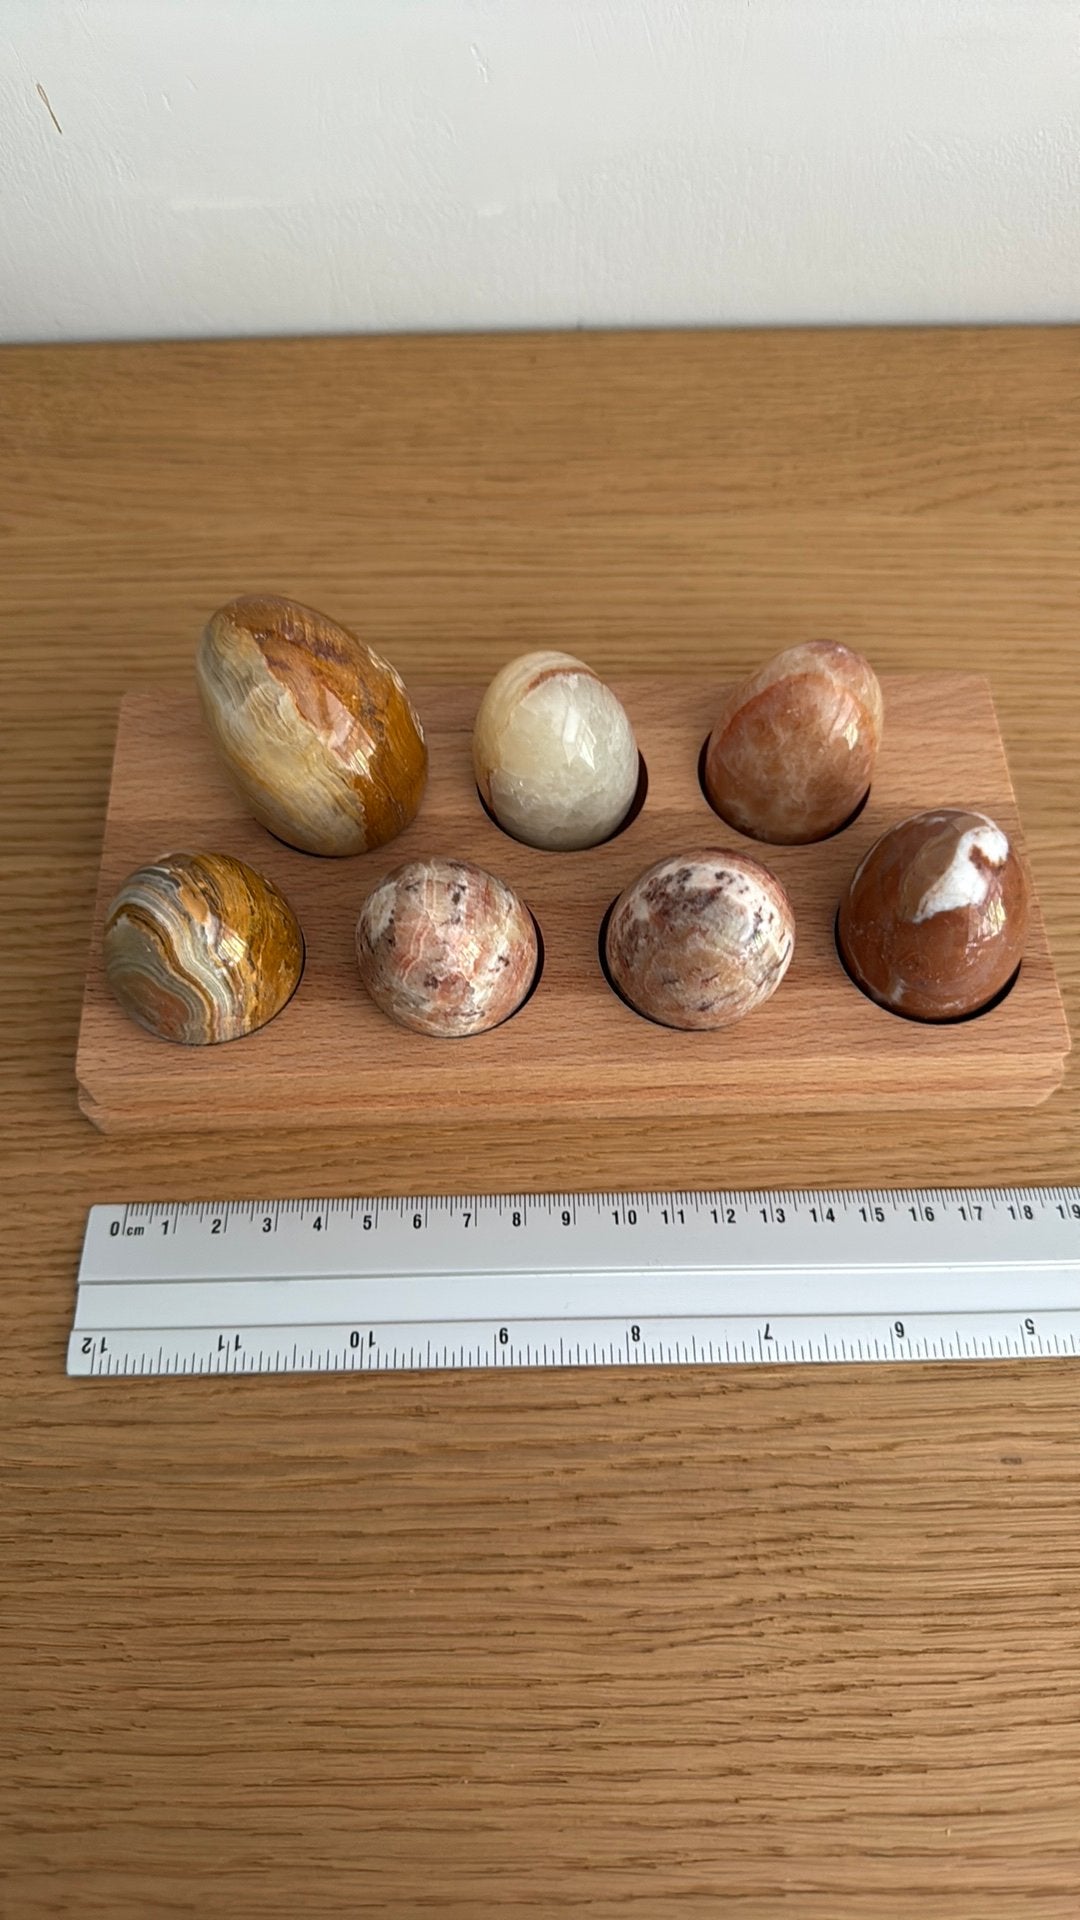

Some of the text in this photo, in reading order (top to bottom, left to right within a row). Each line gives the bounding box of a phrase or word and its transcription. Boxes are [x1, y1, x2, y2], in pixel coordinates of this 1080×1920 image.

[160, 1220, 170, 1236] 1
[210, 1218, 222, 1235] 2
[261, 1217, 272, 1233] 3
[312, 1215, 323, 1232] 4
[362, 1214, 373, 1231] 5
[412, 1213, 423, 1230] 6
[462, 1212, 472, 1229] 7
[511, 1211, 522, 1228] 8
[561, 1210, 571, 1227] 9
[611, 1209, 638, 1226] 10
[660, 1208, 686, 1225] 11
[709, 1208, 737, 1224] 12
[759, 1207, 786, 1224] 13
[808, 1207, 836, 1223] 14
[858, 1206, 886, 1223] 15
[908, 1206, 936, 1222] 16
[957, 1205, 983, 1222] 17
[1007, 1204, 1034, 1221] 18
[1055, 1203, 1080, 1220] 19
[81, 1318, 1036, 1355] 5 6 7 8 9 10 11 12
